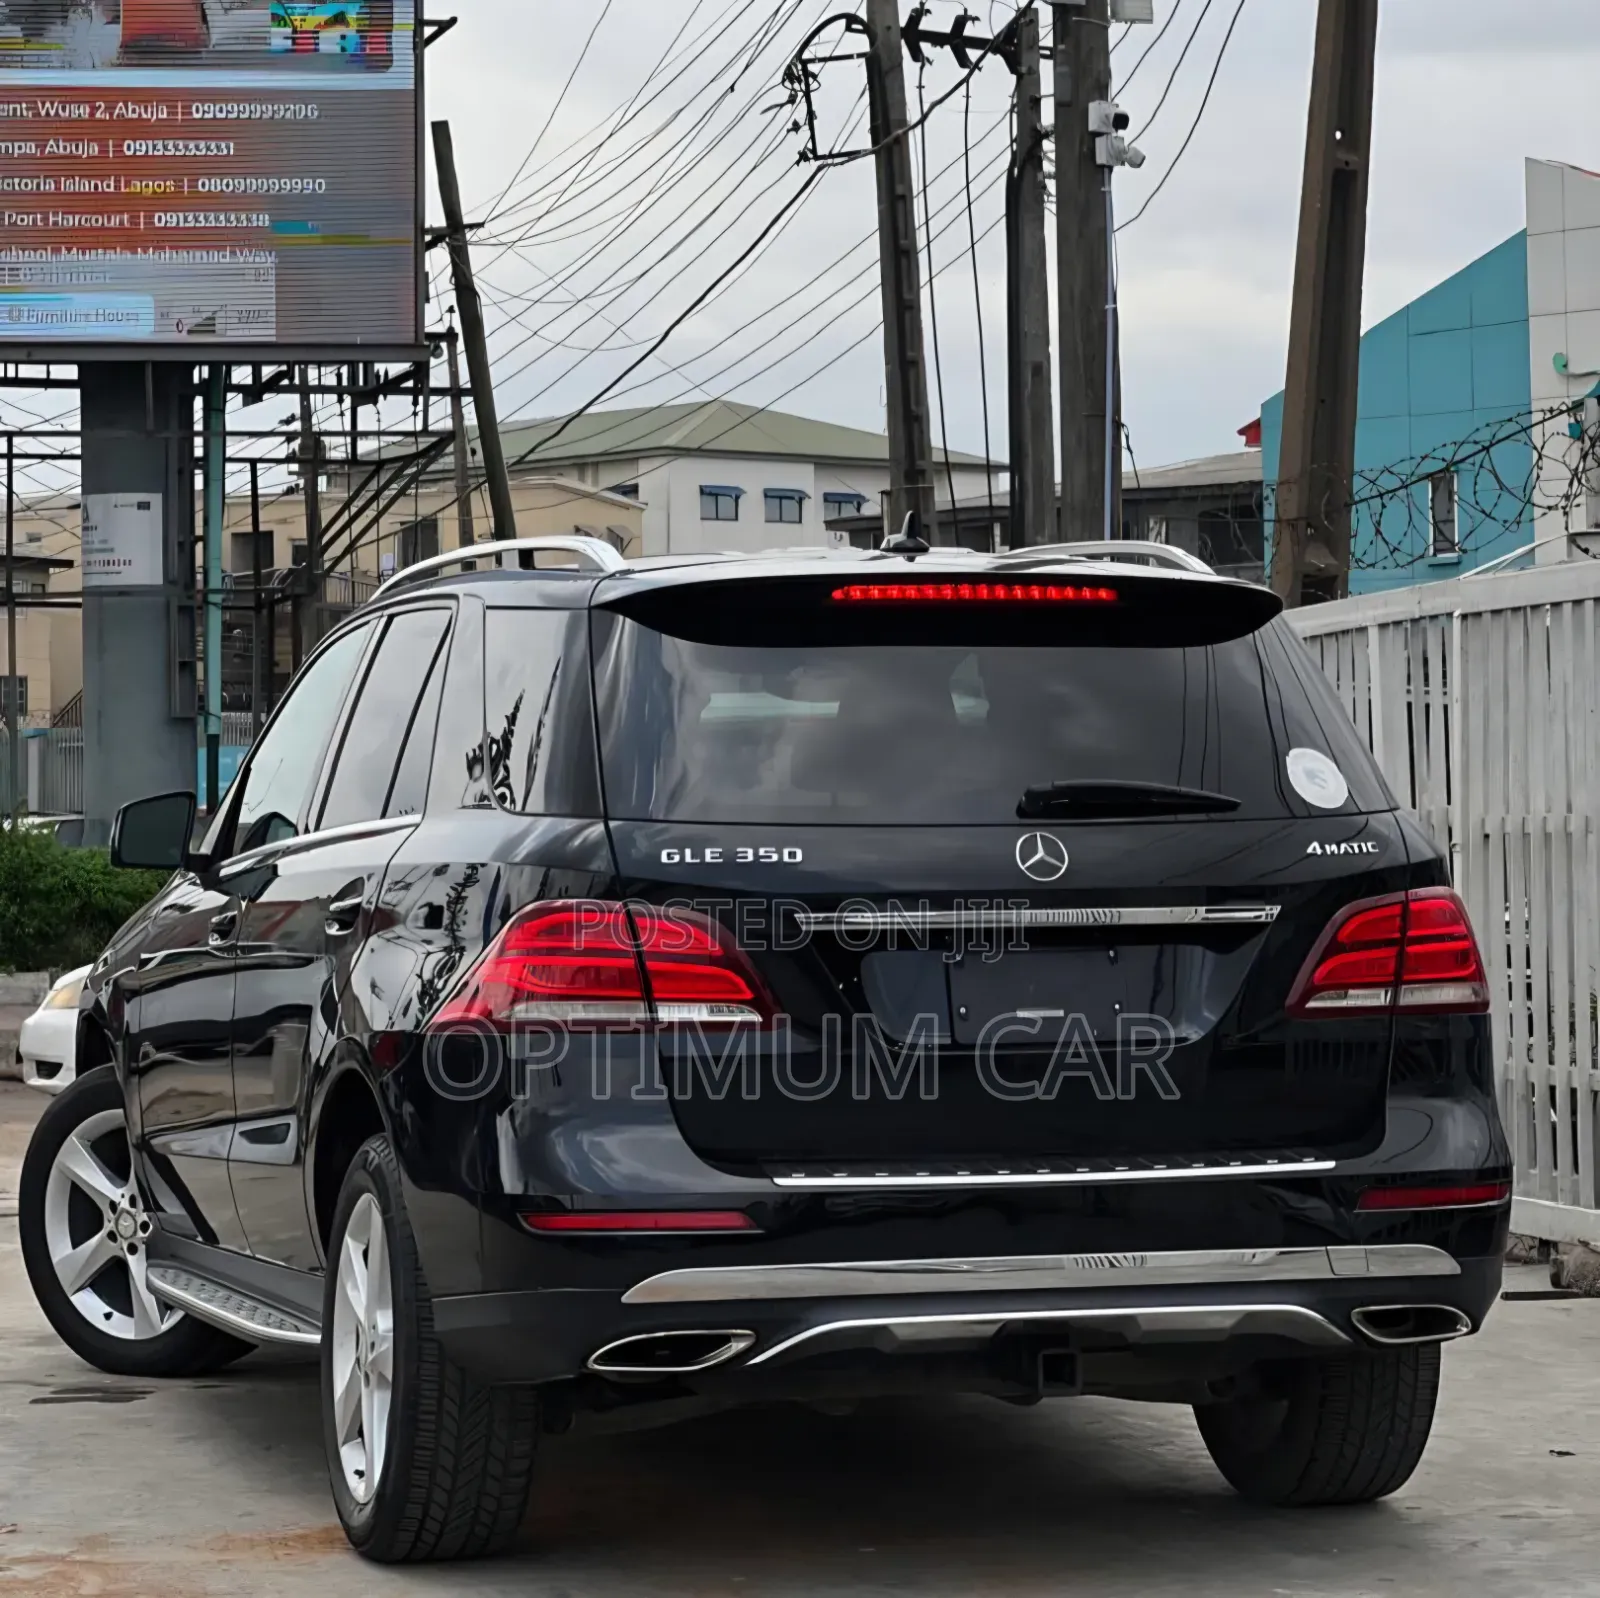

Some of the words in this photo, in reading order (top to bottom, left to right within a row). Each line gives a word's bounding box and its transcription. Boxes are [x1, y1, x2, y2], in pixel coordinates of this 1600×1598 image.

[114, 101, 167, 123] Abuja
[45, 138, 99, 158] Abuja
[0, 175, 55, 191] toria
[121, 176, 175, 195] Lagos
[5, 211, 43, 227] Port
[50, 210, 130, 227] Harcourt
[660, 848, 723, 864] GLE
[736, 847, 803, 863] 350
[1306, 841, 1379, 855] 4MATIC
